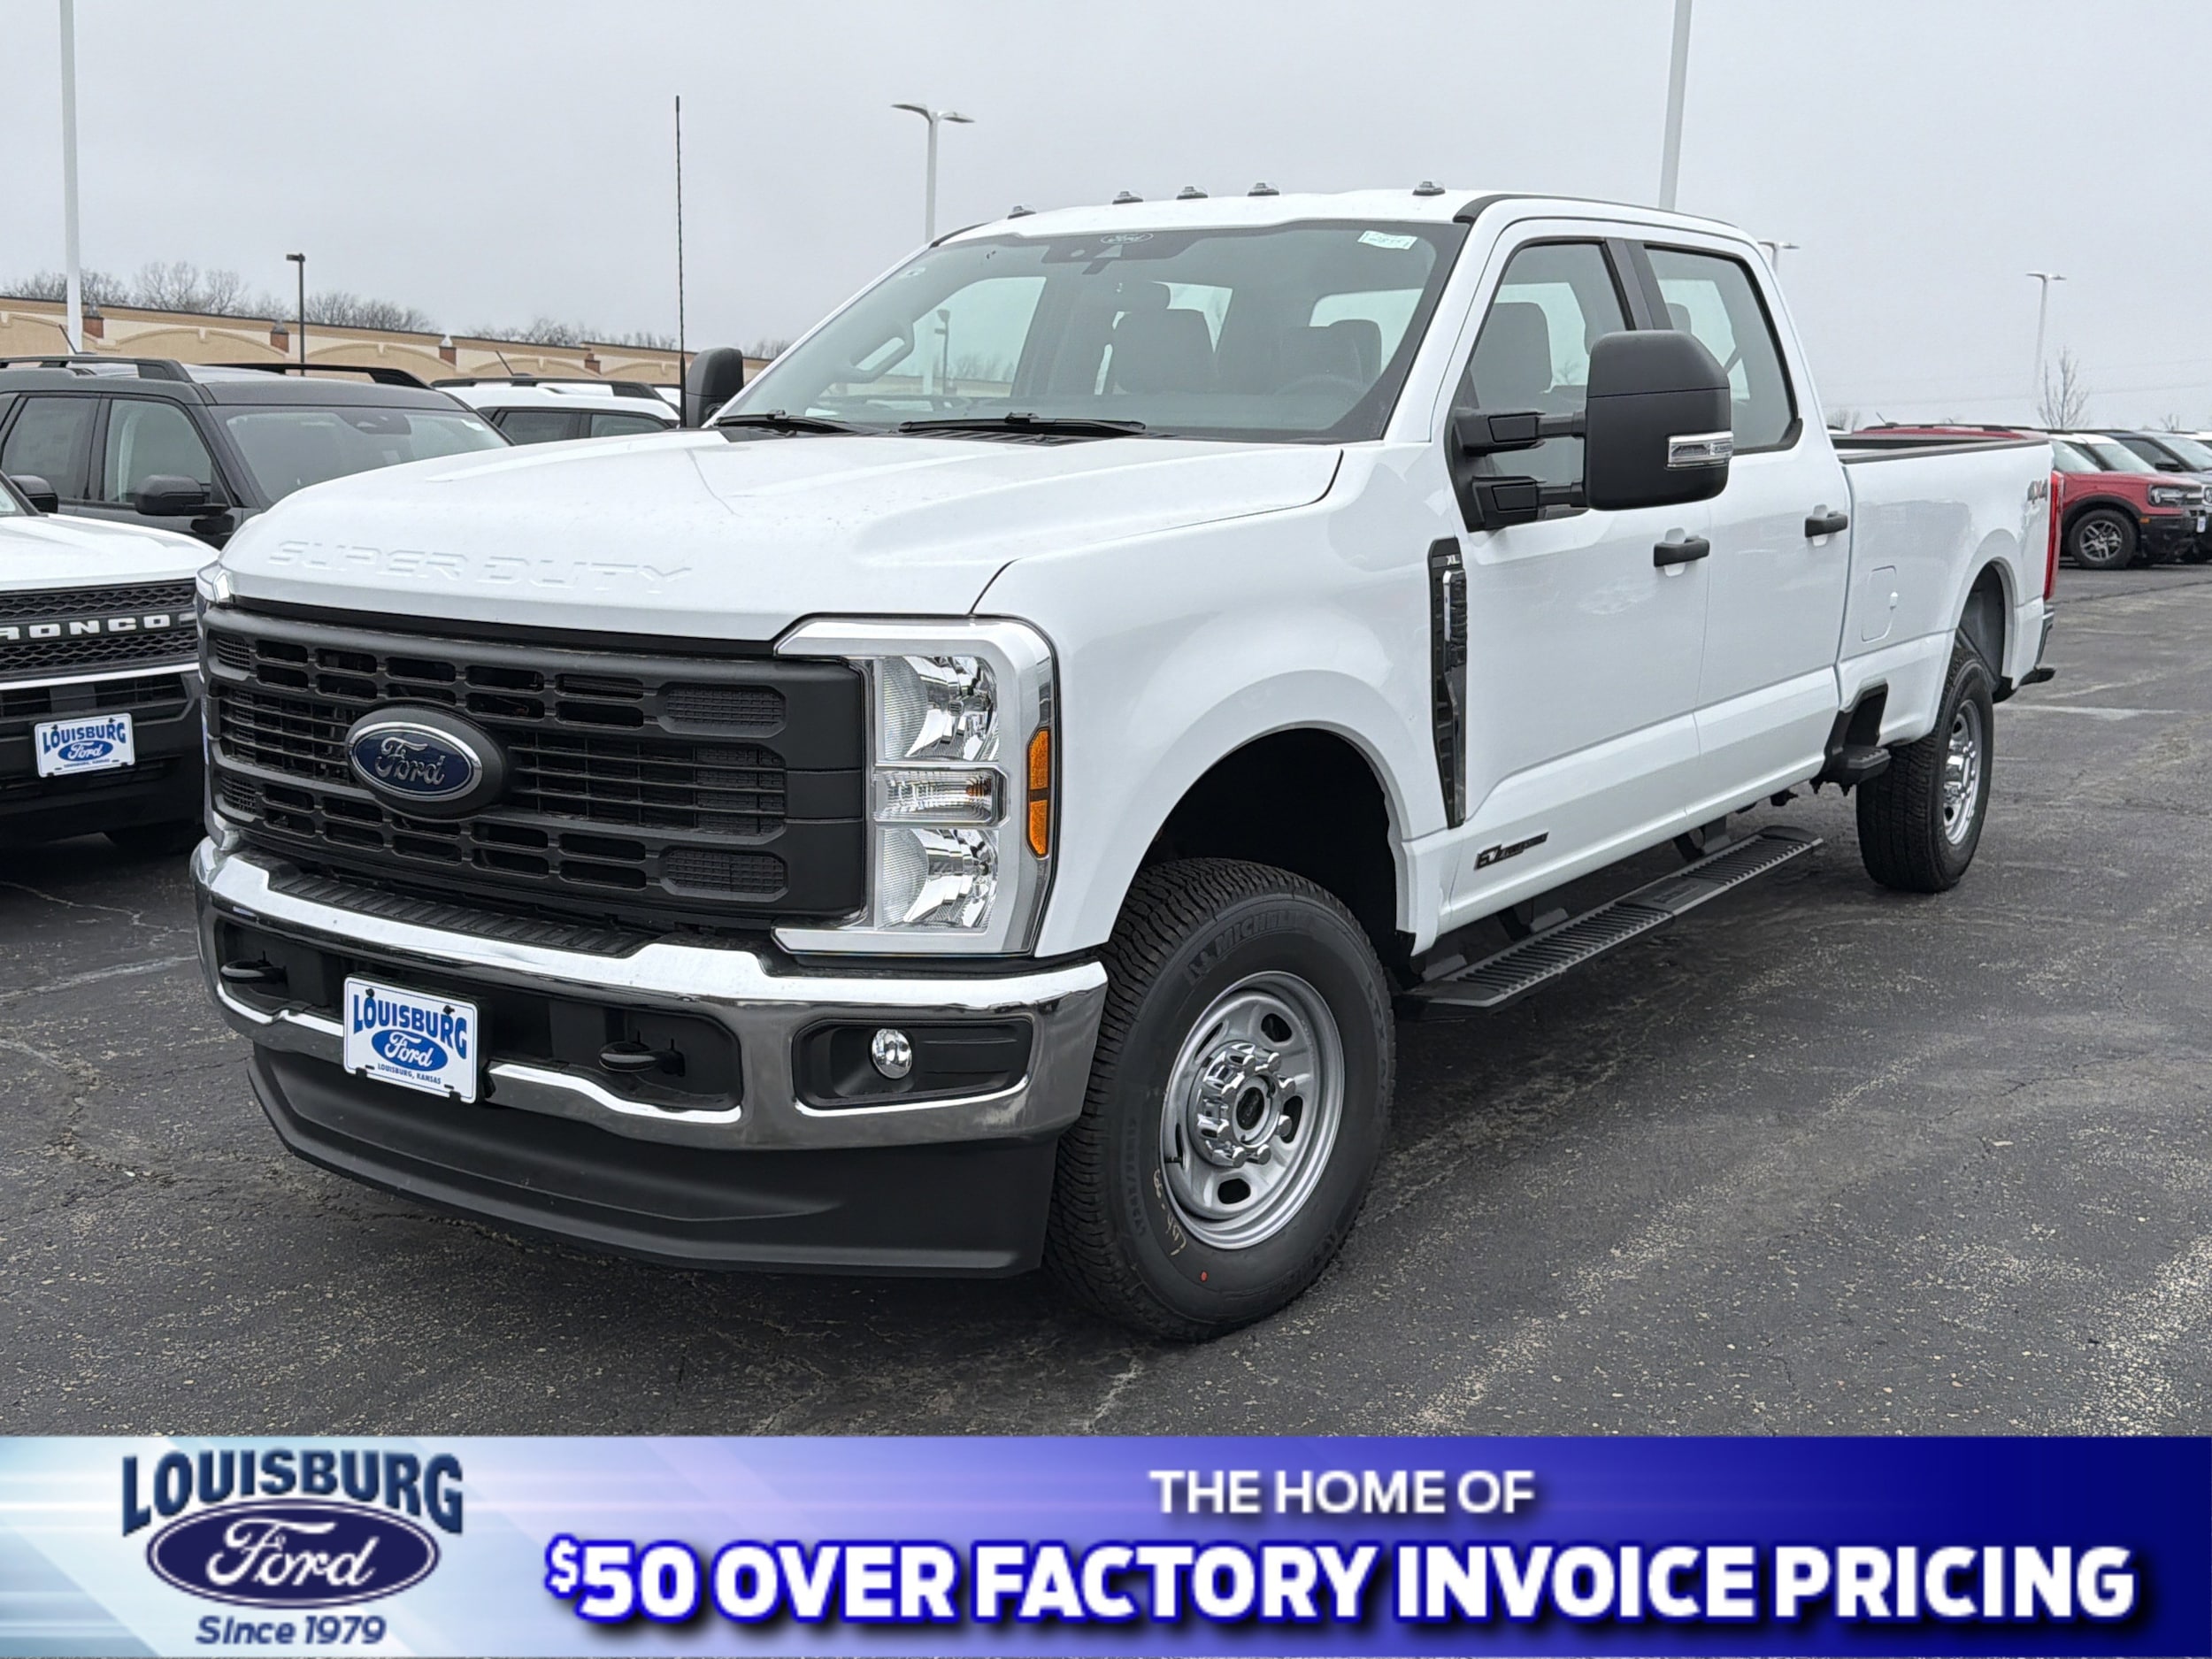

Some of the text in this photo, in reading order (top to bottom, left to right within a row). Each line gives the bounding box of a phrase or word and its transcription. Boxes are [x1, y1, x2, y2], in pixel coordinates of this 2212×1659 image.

[267, 540, 694, 595] SUPER DUTY
[1446, 555, 1460, 565] XL
[42, 721, 127, 756] LOUISBURG
[66, 741, 104, 760] Ford
[374, 736, 445, 786] Ford
[353, 994, 467, 1060] LOUISBURG
[384, 1032, 434, 1067] Ford
[378, 1063, 442, 1085] LOUISBURG, KANSAS
